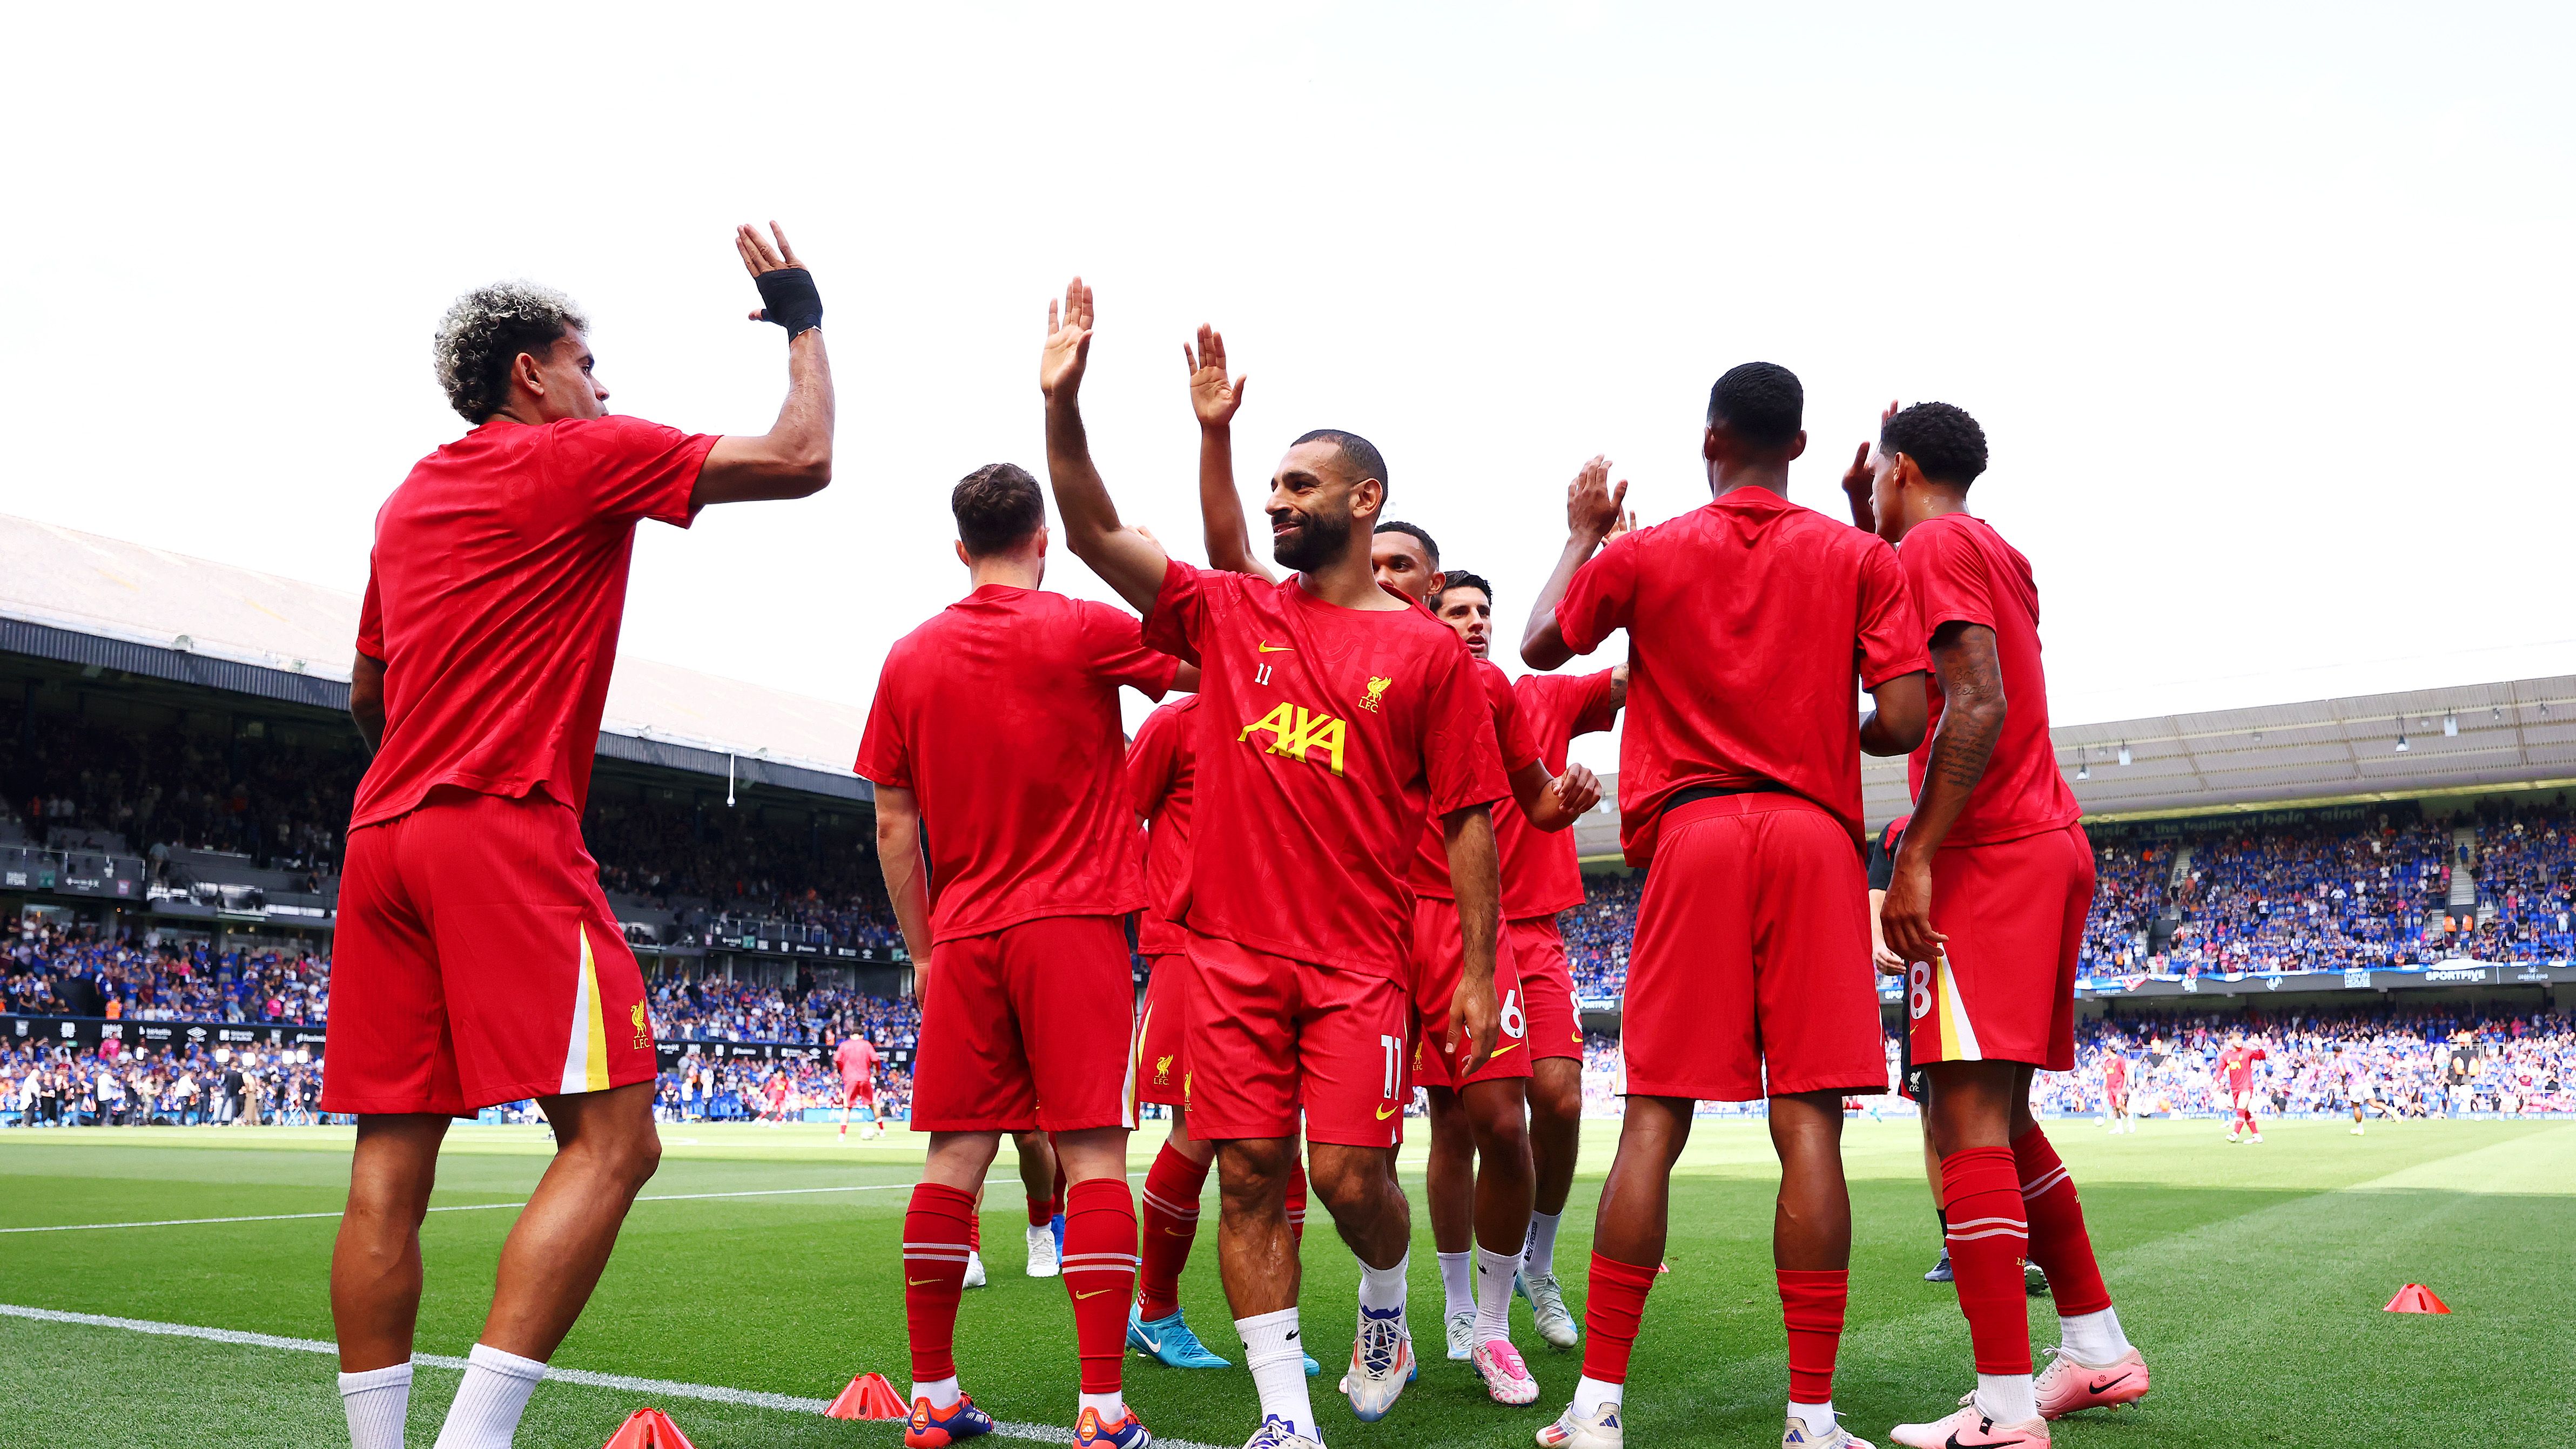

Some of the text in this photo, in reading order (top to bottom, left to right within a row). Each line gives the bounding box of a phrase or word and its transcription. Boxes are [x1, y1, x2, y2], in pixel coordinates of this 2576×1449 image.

[1254, 663, 1272, 685] 11
[1237, 702, 1347, 778] AXA
[2425, 969, 2486, 982] SPORTFIVE
[1381, 1034, 1401, 1101] 11
